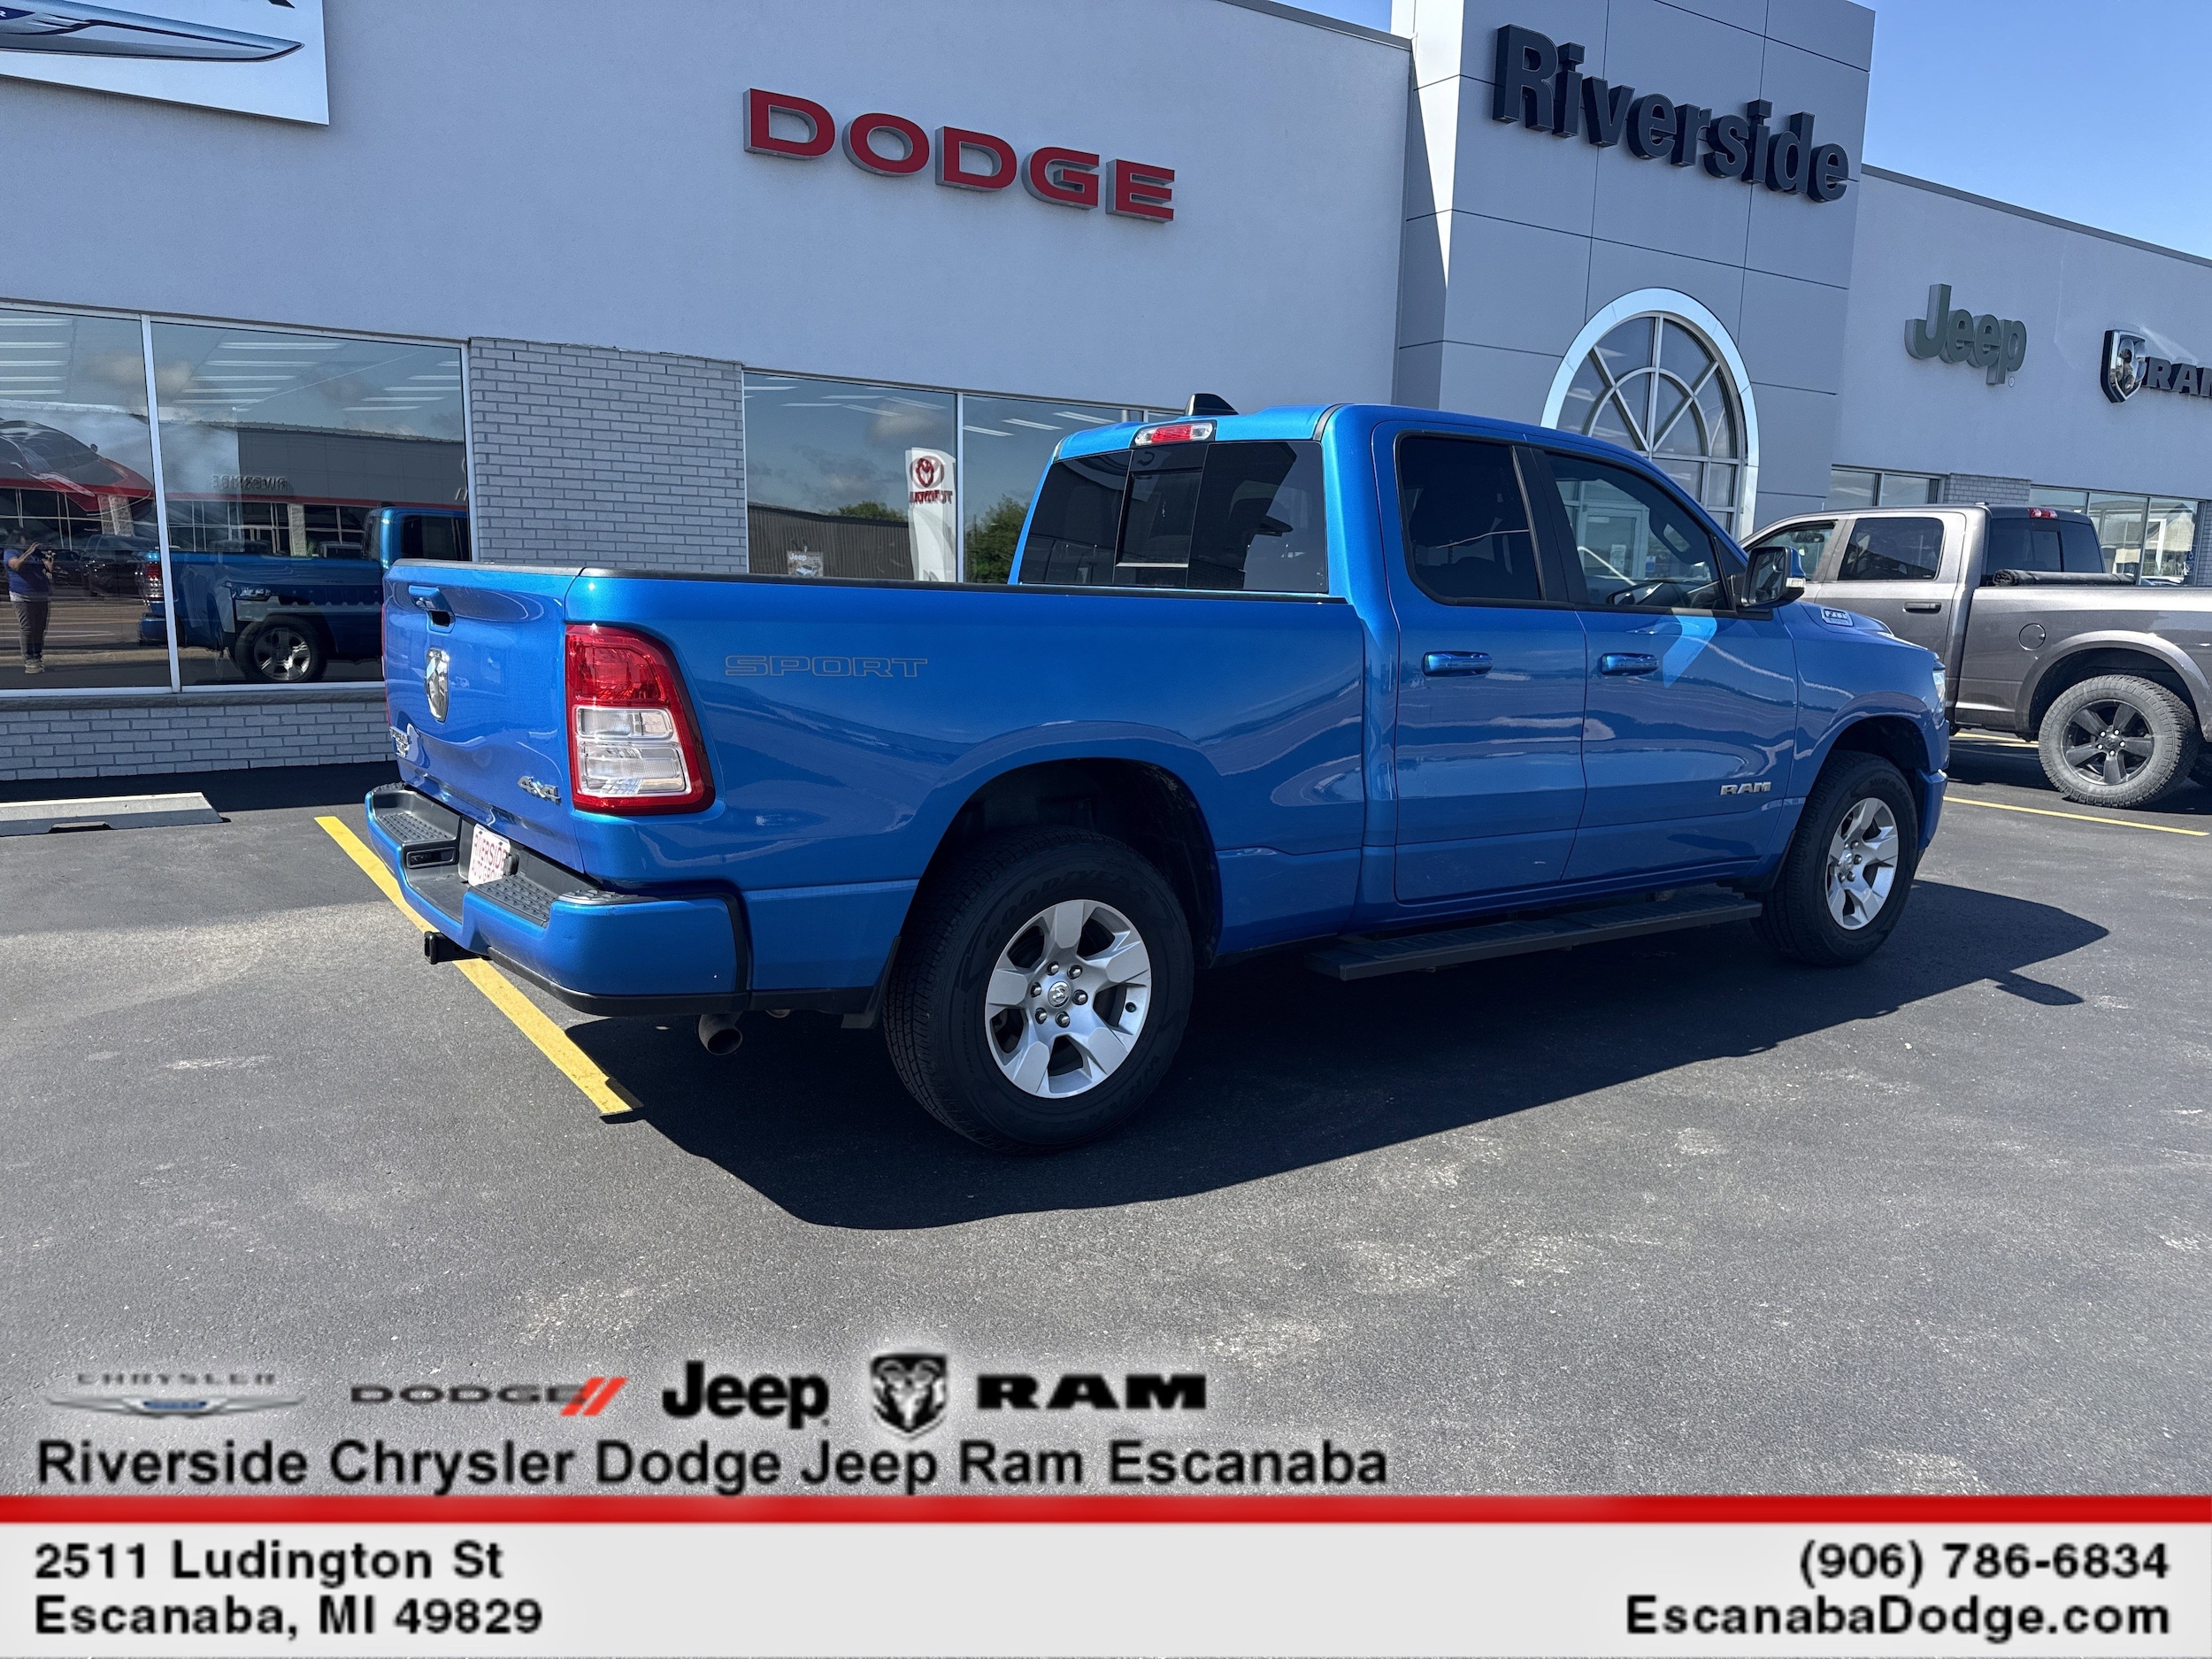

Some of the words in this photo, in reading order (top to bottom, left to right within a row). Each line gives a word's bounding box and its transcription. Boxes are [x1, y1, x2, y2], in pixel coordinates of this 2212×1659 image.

[743, 88, 1176, 224] DODGE
[1492, 23, 1850, 204] Riverside
[1904, 283, 2027, 385] Jeep
[725, 654, 929, 679] SPORT
[1719, 780, 1772, 797] RAM
